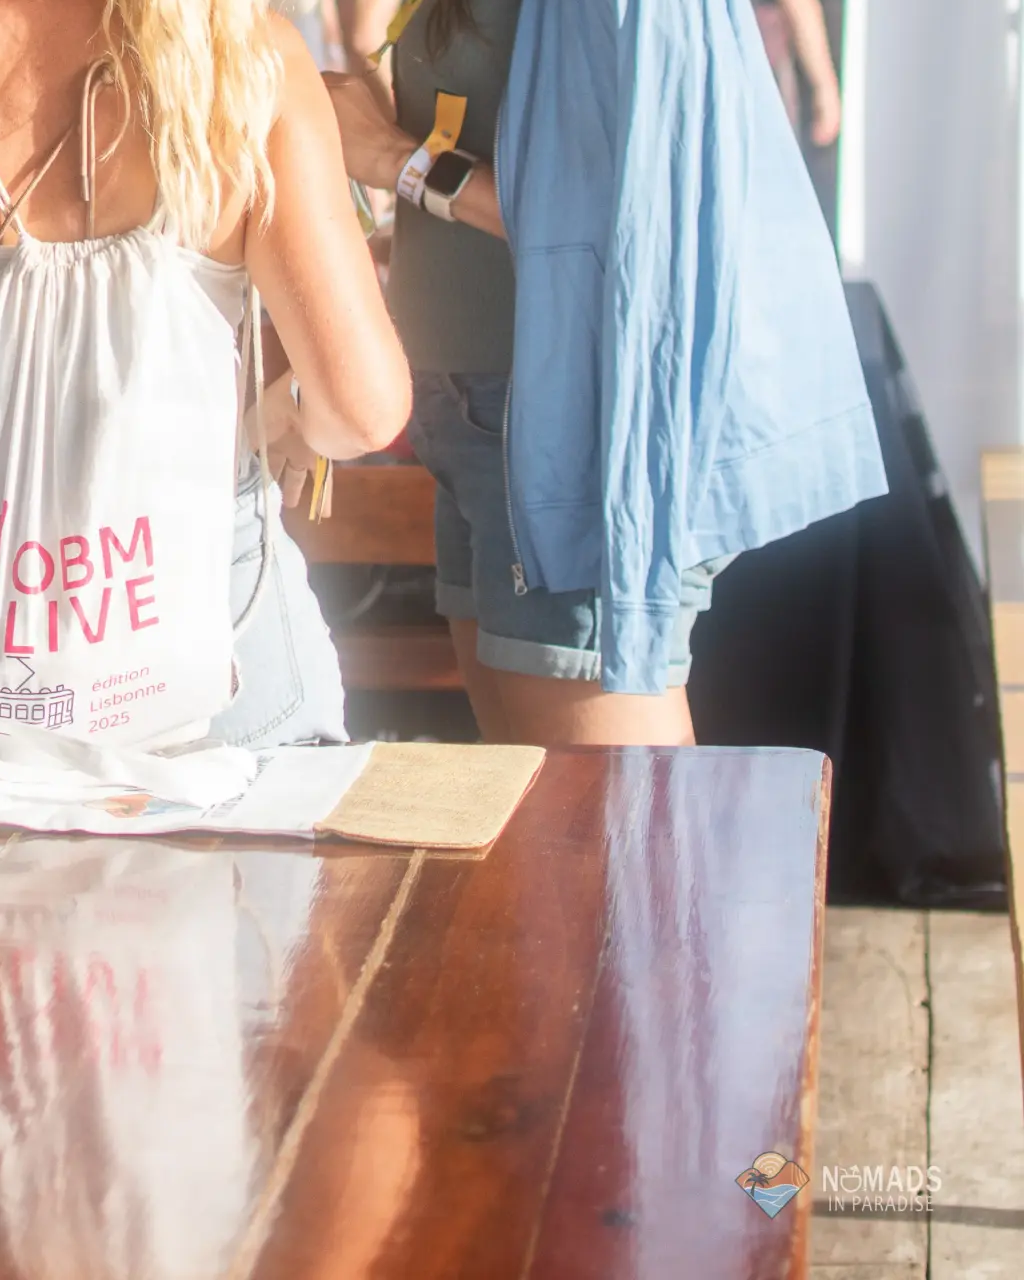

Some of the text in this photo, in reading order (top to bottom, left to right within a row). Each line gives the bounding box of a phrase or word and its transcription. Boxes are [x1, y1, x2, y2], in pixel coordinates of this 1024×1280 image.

[11, 516, 154, 595] OBM
[4, 575, 159, 654] LIVE
[91, 666, 150, 692] édition
[89, 681, 166, 712] Lisbonne
[88, 711, 131, 733] 2025
